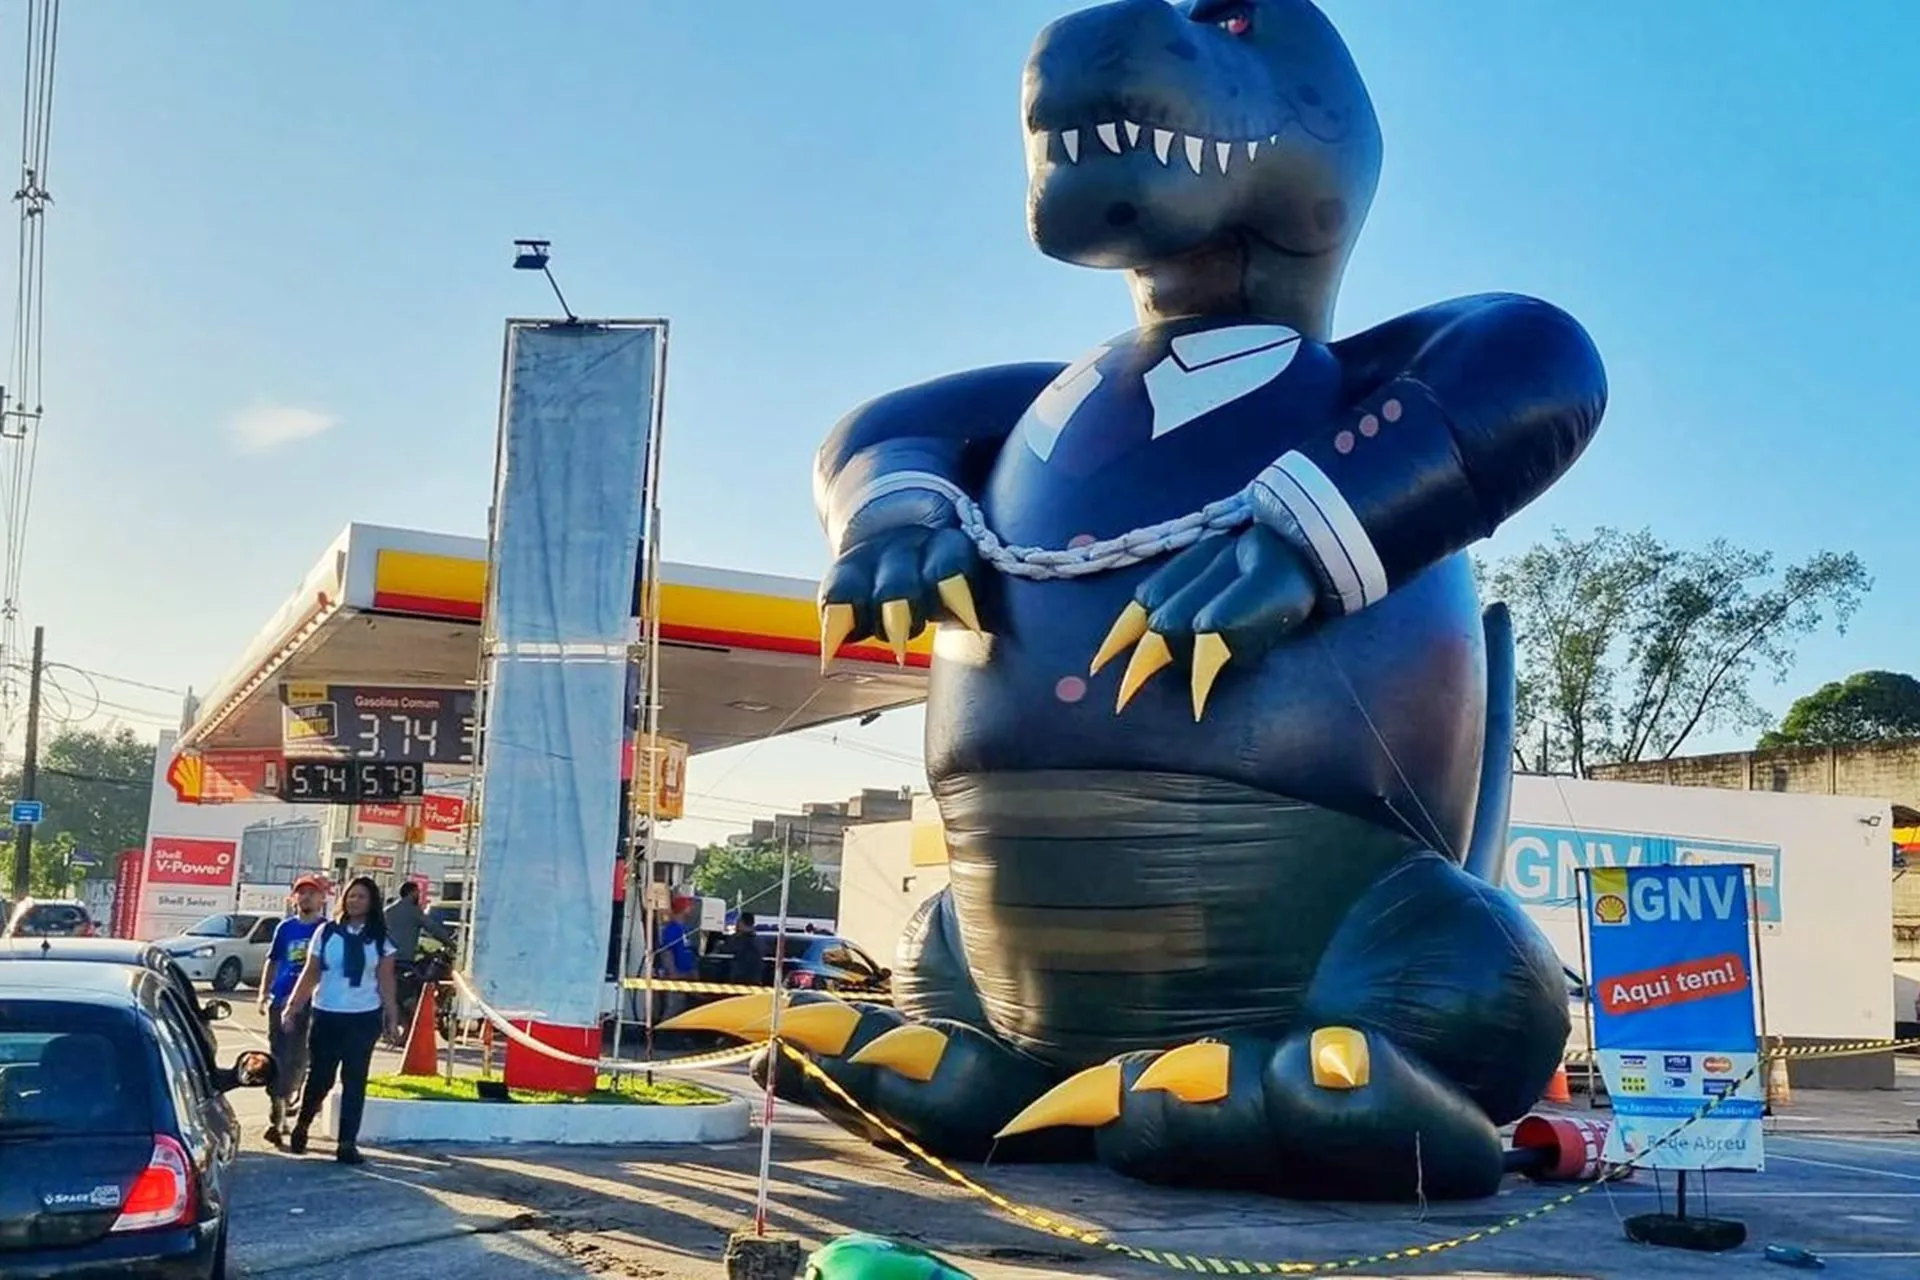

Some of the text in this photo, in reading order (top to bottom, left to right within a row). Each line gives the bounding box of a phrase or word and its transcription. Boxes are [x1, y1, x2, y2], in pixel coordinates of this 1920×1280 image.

[355, 695, 439, 709] Gasolina Comum
[155, 849, 182, 860] Shell
[155, 860, 225, 876] V-Power
[1632, 875, 1738, 922] GNV
[1611, 961, 1736, 1005] Aqui tem!
[1693, 1137, 1746, 1151] Abreu
